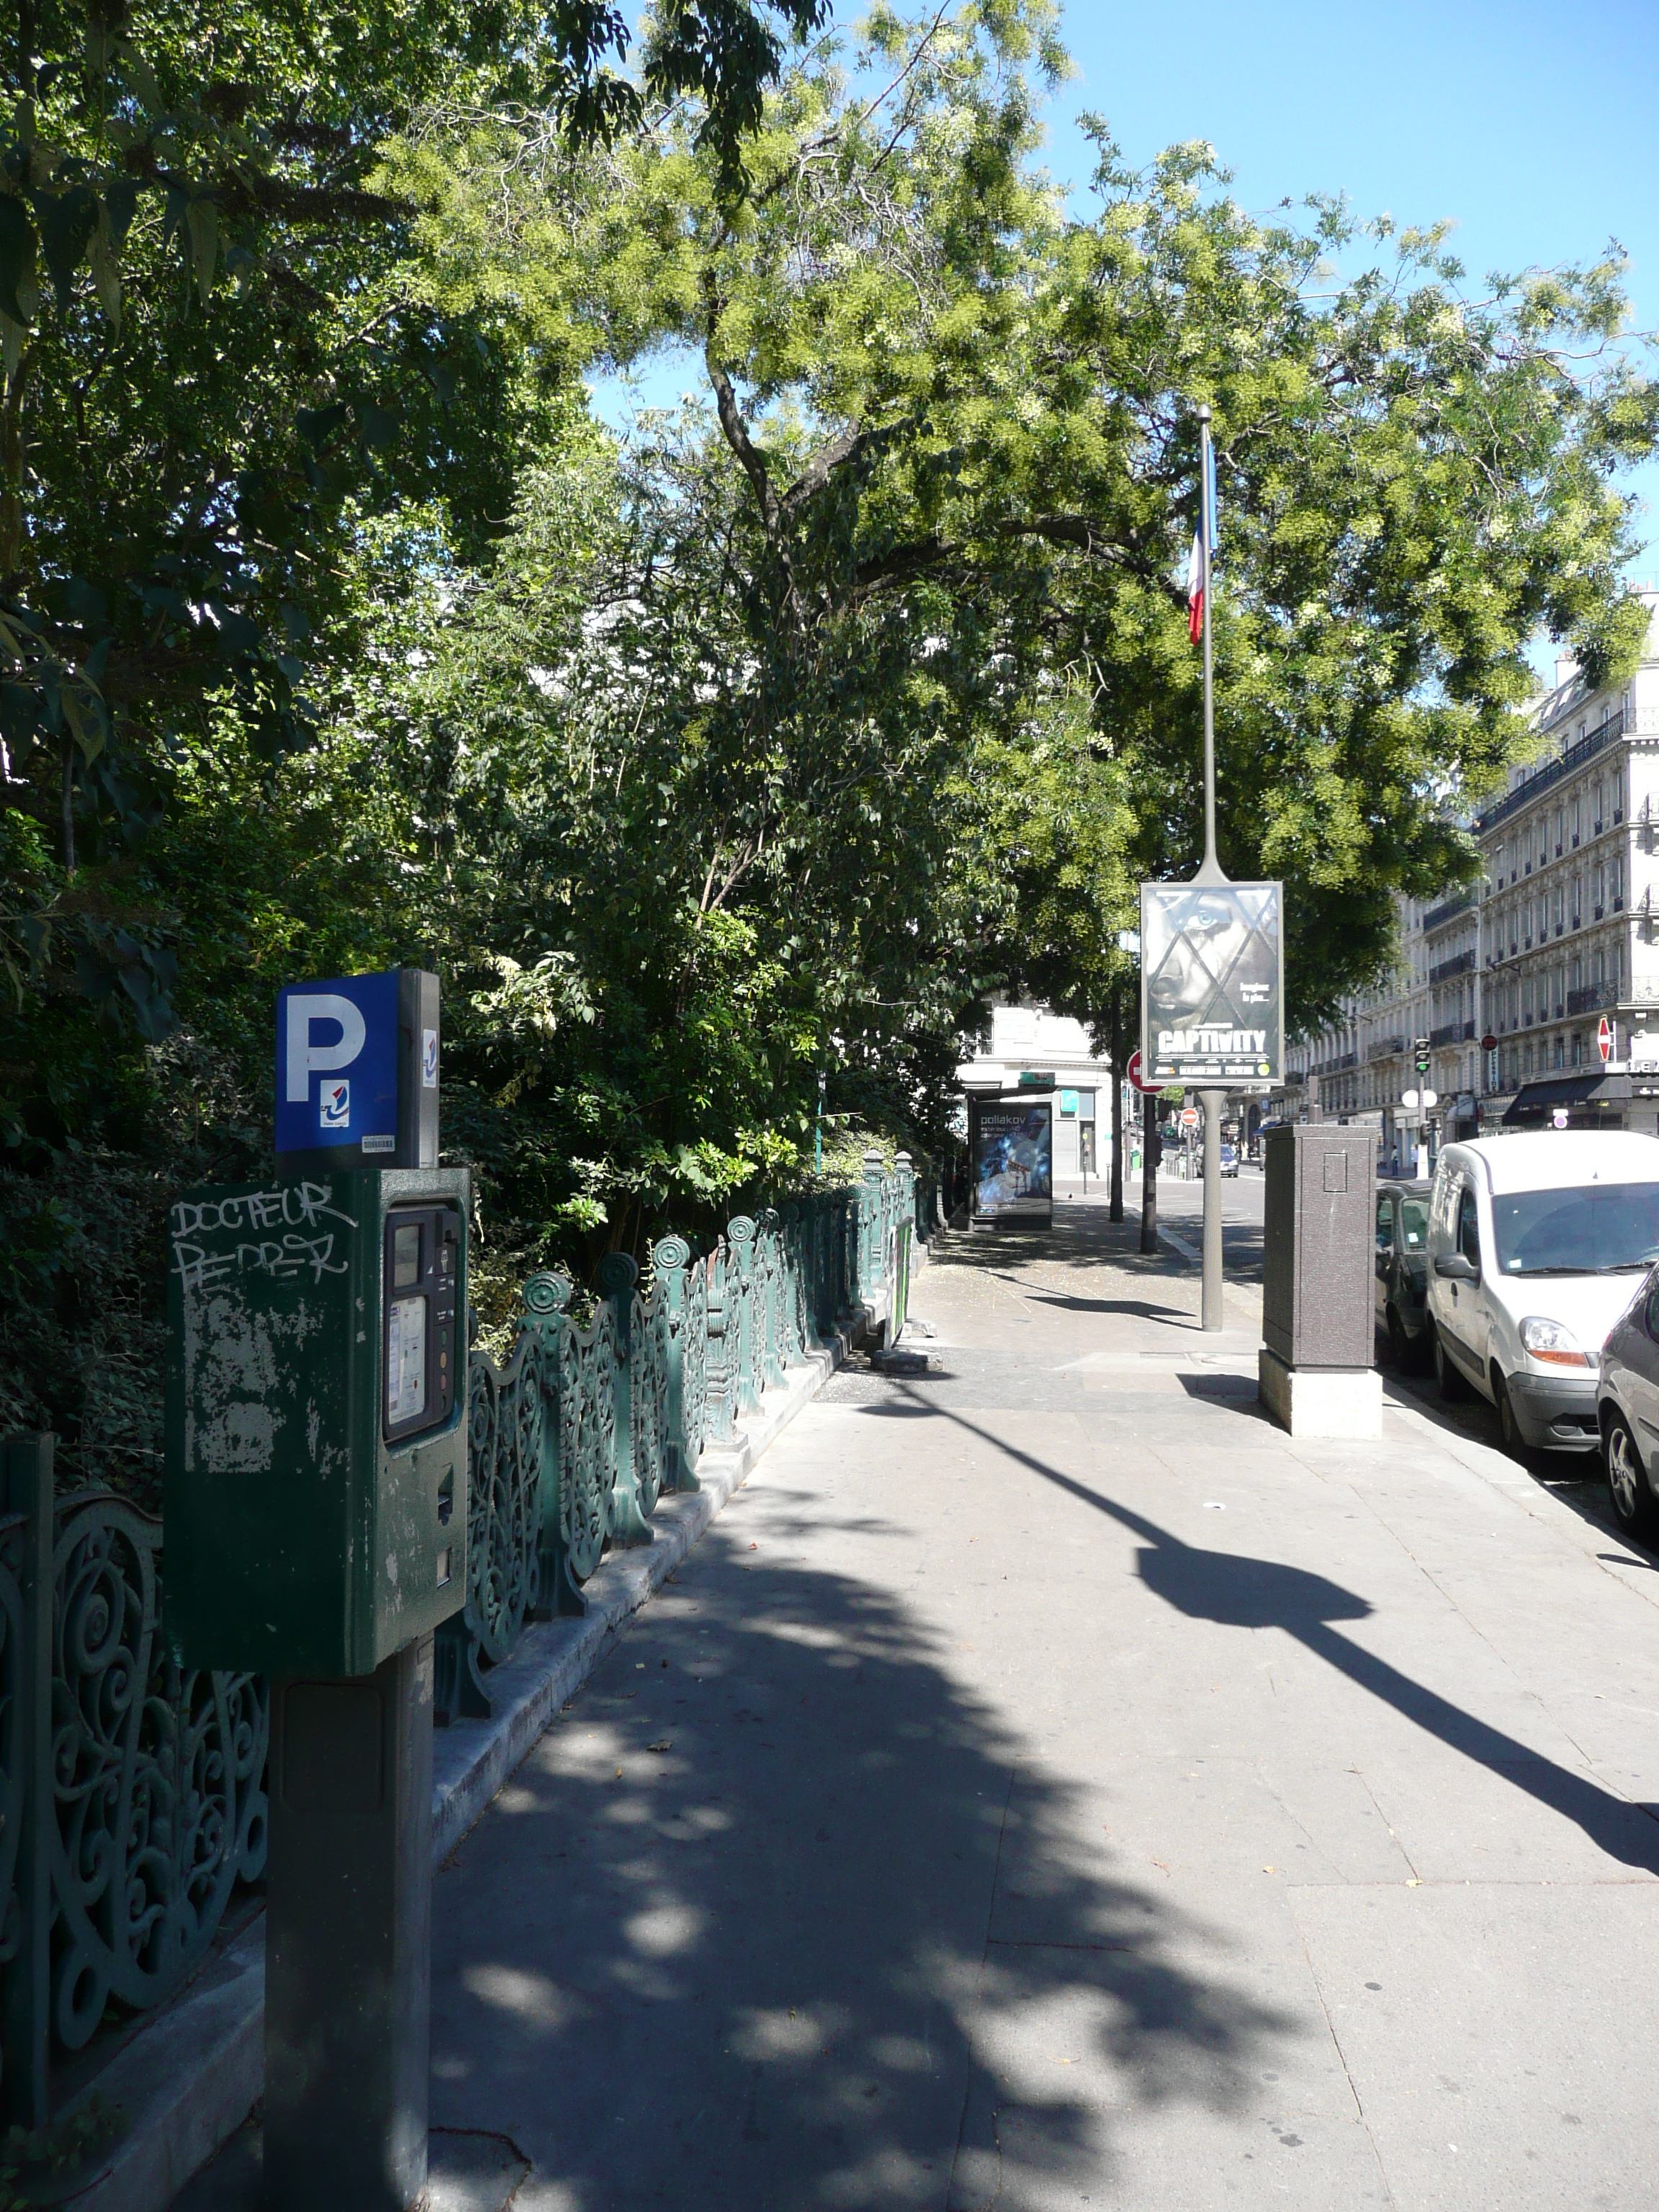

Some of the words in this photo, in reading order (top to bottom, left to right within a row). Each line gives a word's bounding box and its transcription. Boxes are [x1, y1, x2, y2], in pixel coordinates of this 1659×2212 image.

[287, 994, 366, 1102] P
[1158, 1030, 1266, 1053] CAPTIVITY
[981, 1115, 1025, 1125] poliakov
[171, 1181, 359, 1238] DOCTEUR
